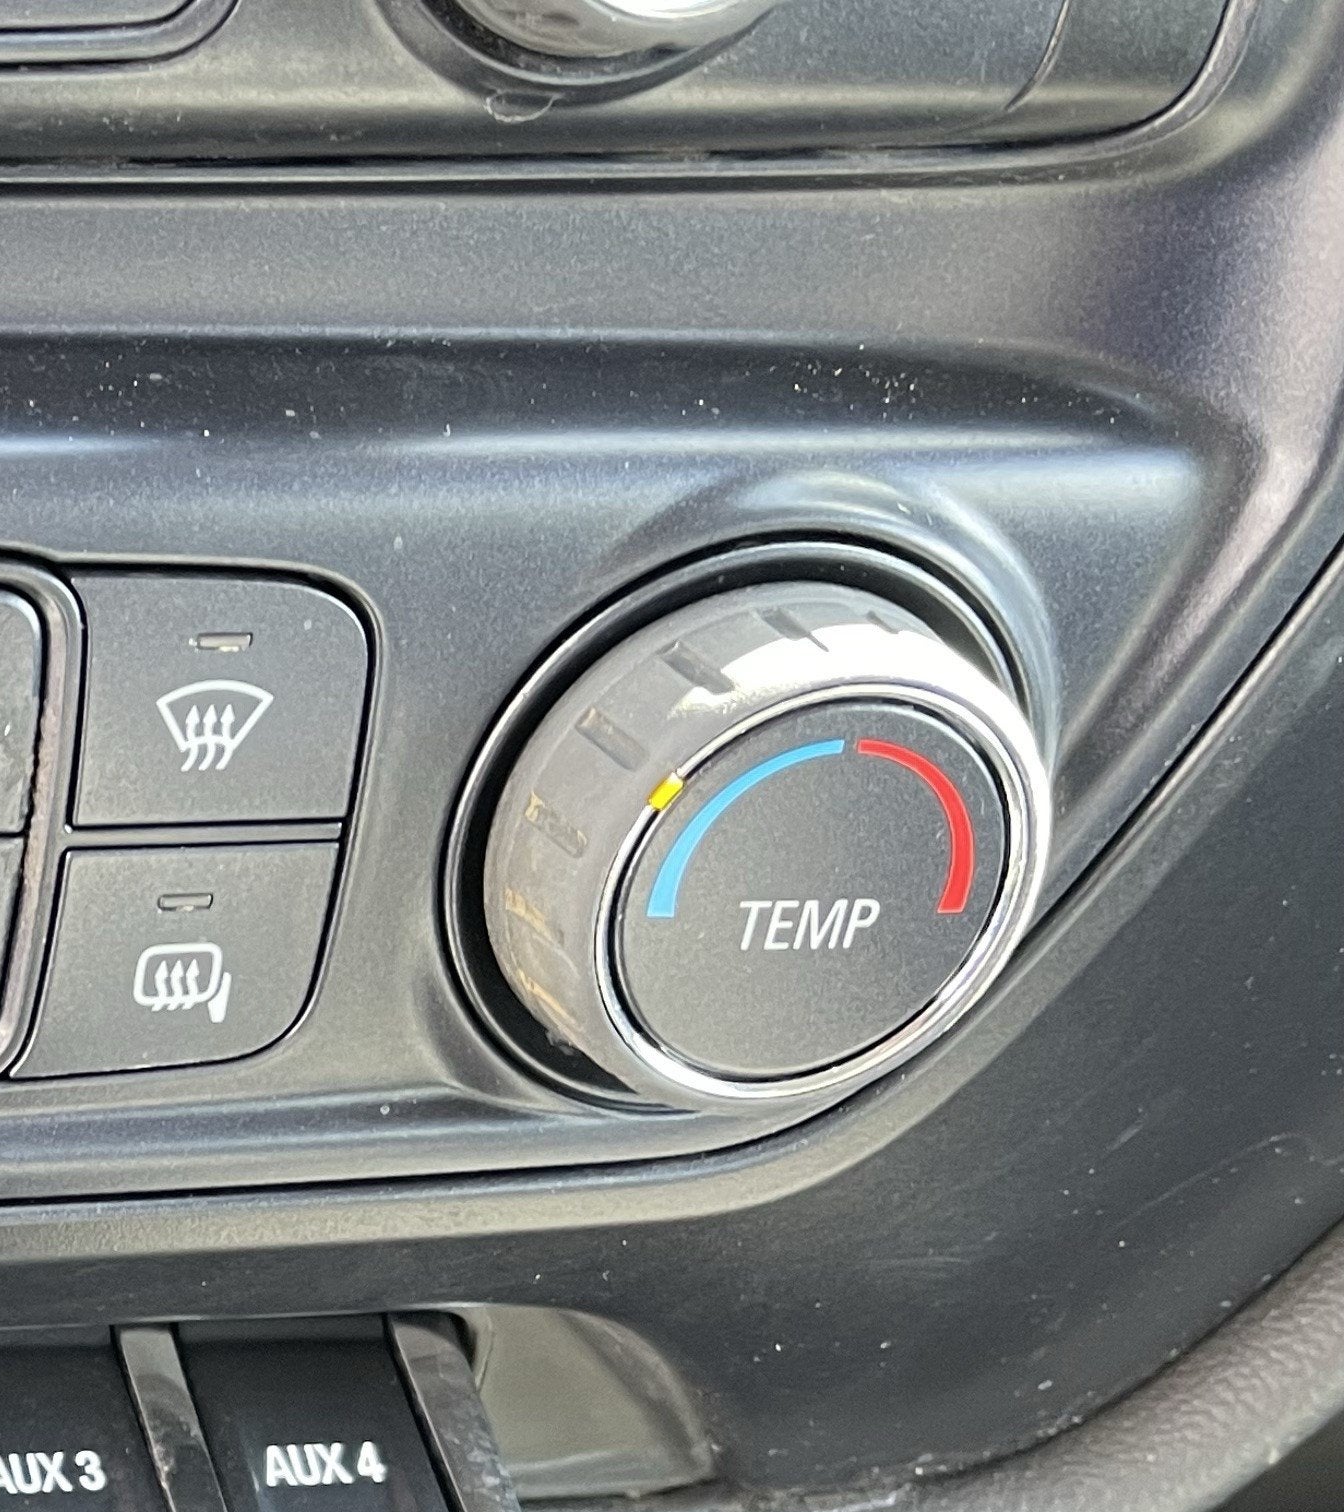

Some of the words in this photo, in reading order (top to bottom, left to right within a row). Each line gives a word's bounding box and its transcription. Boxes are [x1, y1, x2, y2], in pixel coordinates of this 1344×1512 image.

[739, 898, 881, 951] TEMP
[76, 1450, 107, 1492] 3
[265, 1442, 354, 1487] AUX
[356, 1441, 387, 1483] 4
